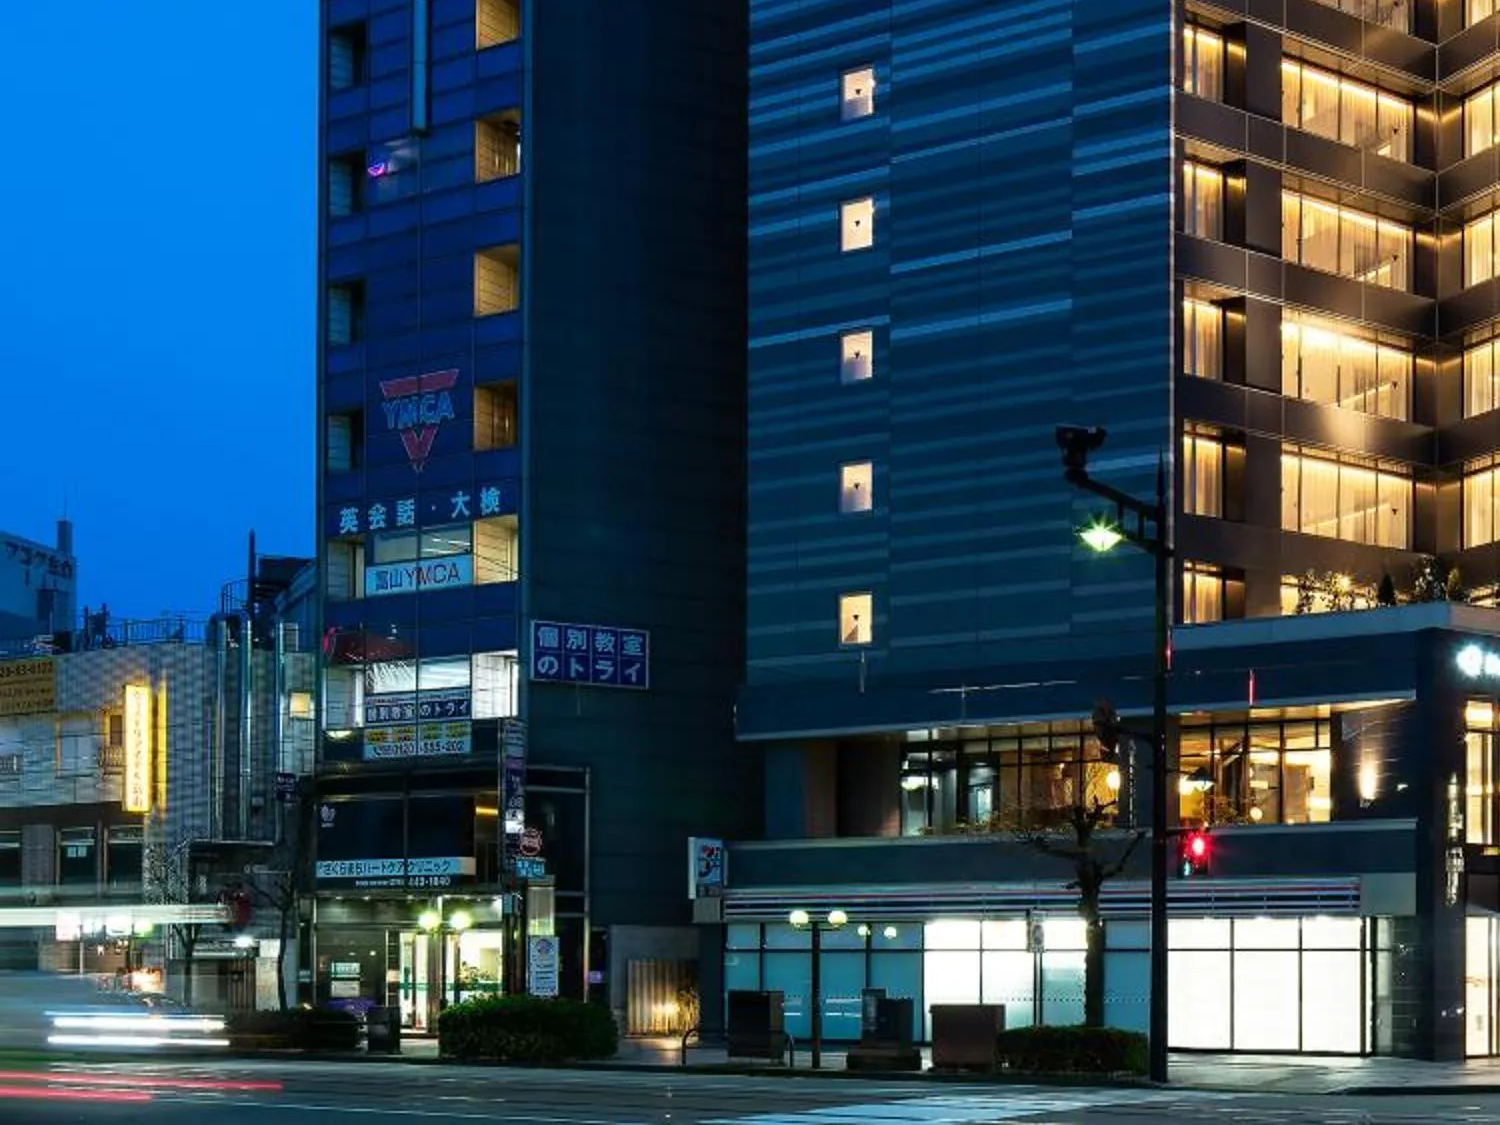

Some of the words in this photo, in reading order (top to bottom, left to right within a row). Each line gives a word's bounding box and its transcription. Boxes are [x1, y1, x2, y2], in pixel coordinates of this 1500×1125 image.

[382, 391, 455, 430] YMCA
[537, 626, 644, 656] 個別教室
[537, 656, 641, 683] のトライ
